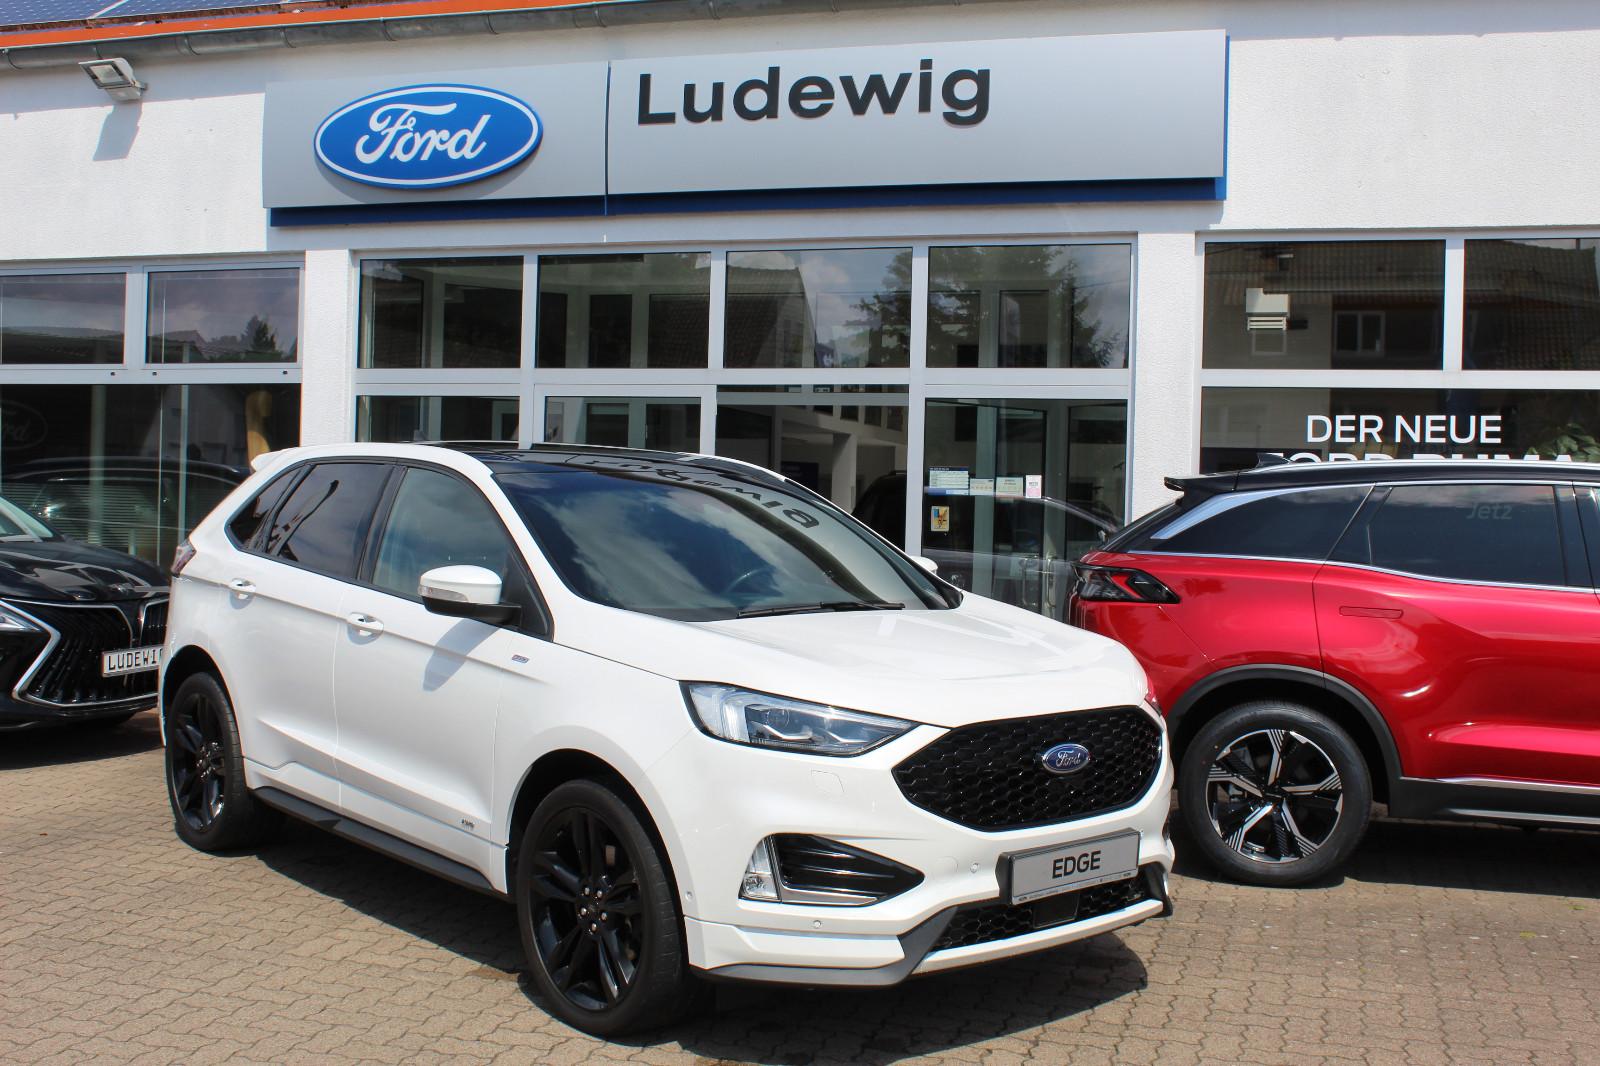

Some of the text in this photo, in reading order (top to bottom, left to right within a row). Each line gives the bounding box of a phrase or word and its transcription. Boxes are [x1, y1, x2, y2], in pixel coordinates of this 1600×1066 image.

[638, 58, 990, 126] Ludewig
[355, 103, 491, 164] Ford
[1306, 414, 1502, 444] DER NEUE
[1056, 749, 1081, 767] Ford
[1052, 850, 1102, 879] EDGE
